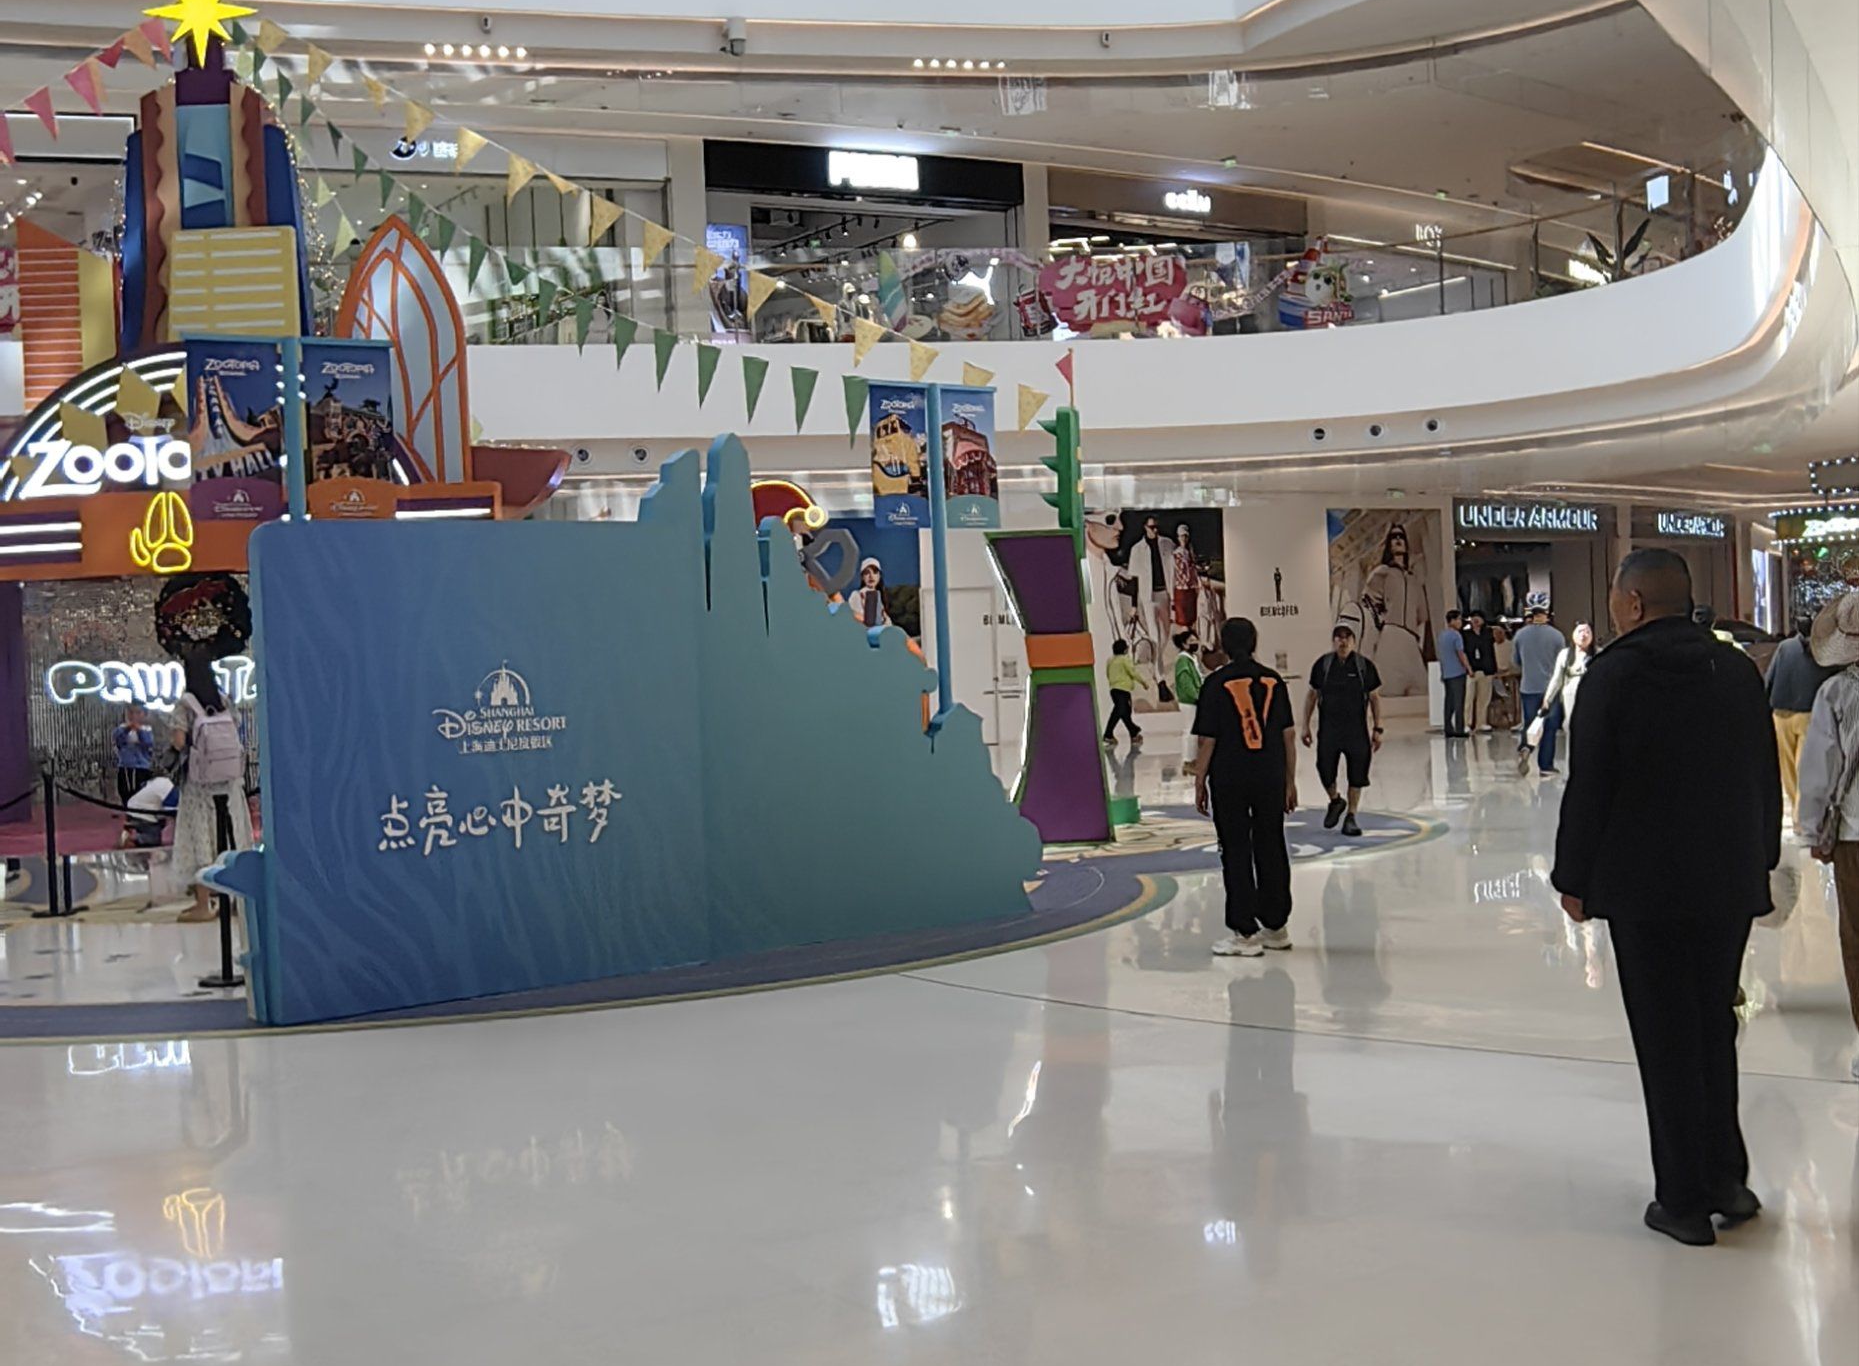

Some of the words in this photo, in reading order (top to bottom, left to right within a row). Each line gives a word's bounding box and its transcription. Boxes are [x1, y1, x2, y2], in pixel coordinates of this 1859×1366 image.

[1459, 505, 1525, 528] UNDER
[1528, 504, 1598, 531] ARMOUR
[480, 706, 535, 719] SHANGHAI
[516, 715, 567, 732] RESORT
[377, 778, 623, 857] 点亮心中奇梦
